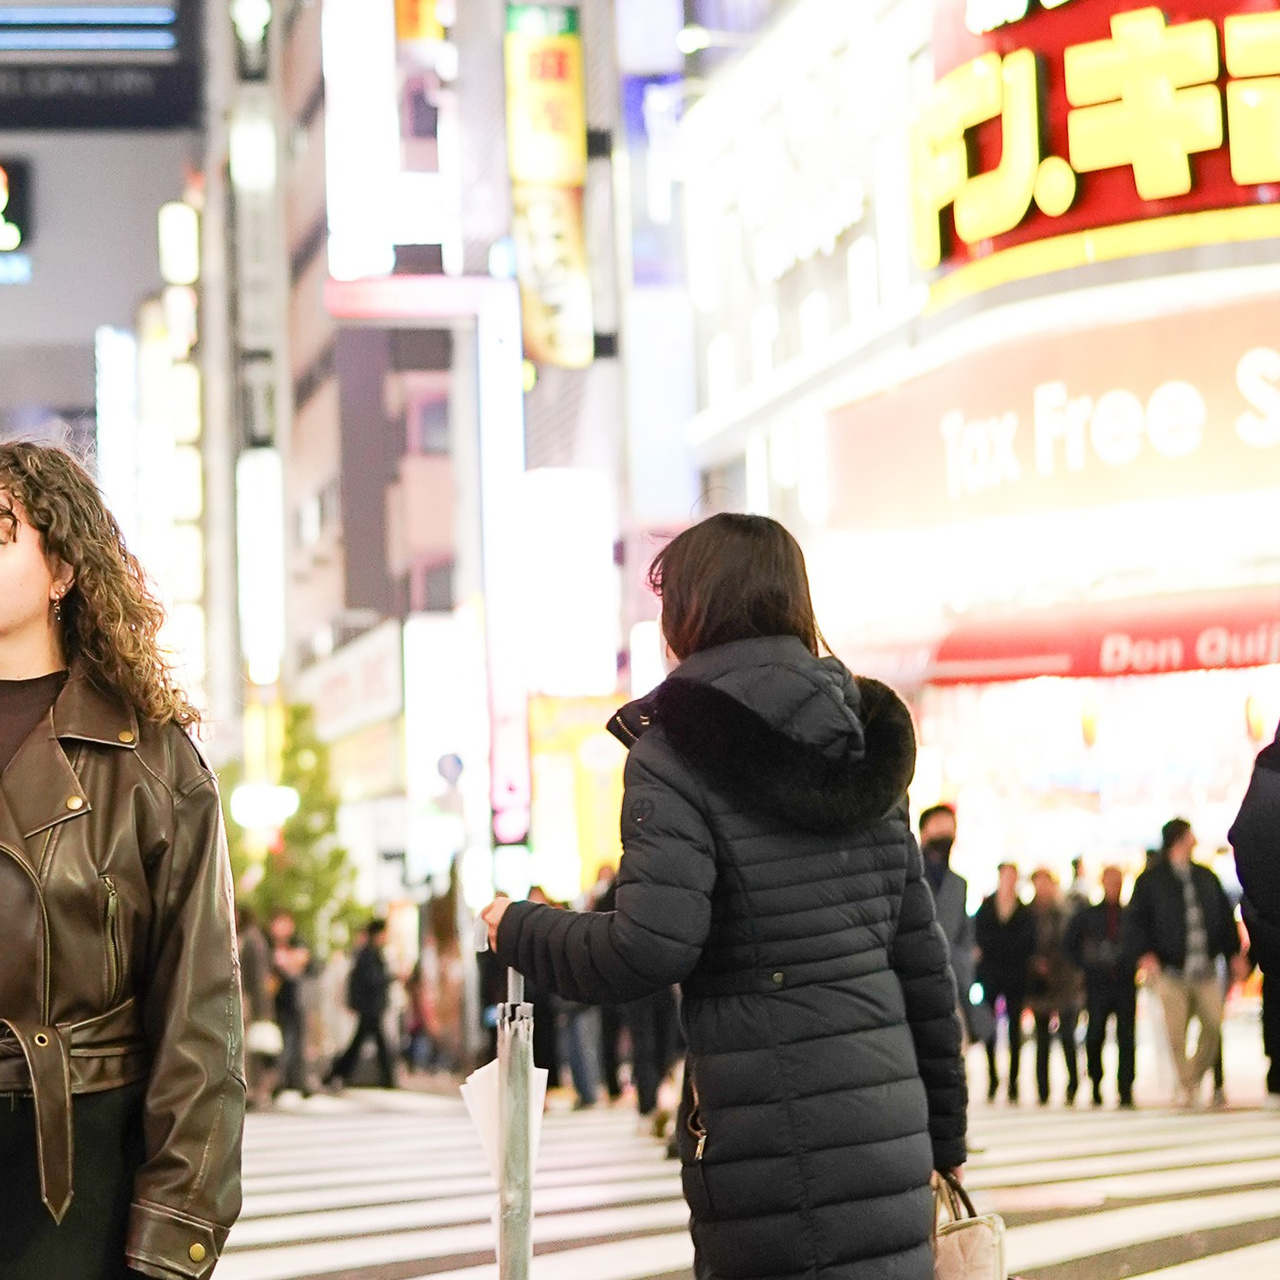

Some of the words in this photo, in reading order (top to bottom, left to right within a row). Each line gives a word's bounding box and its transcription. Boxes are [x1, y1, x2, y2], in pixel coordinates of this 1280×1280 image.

[940, 409, 1019, 499] Tax
[1033, 379, 1207, 477] Free
[1100, 633, 1184, 673] Don
